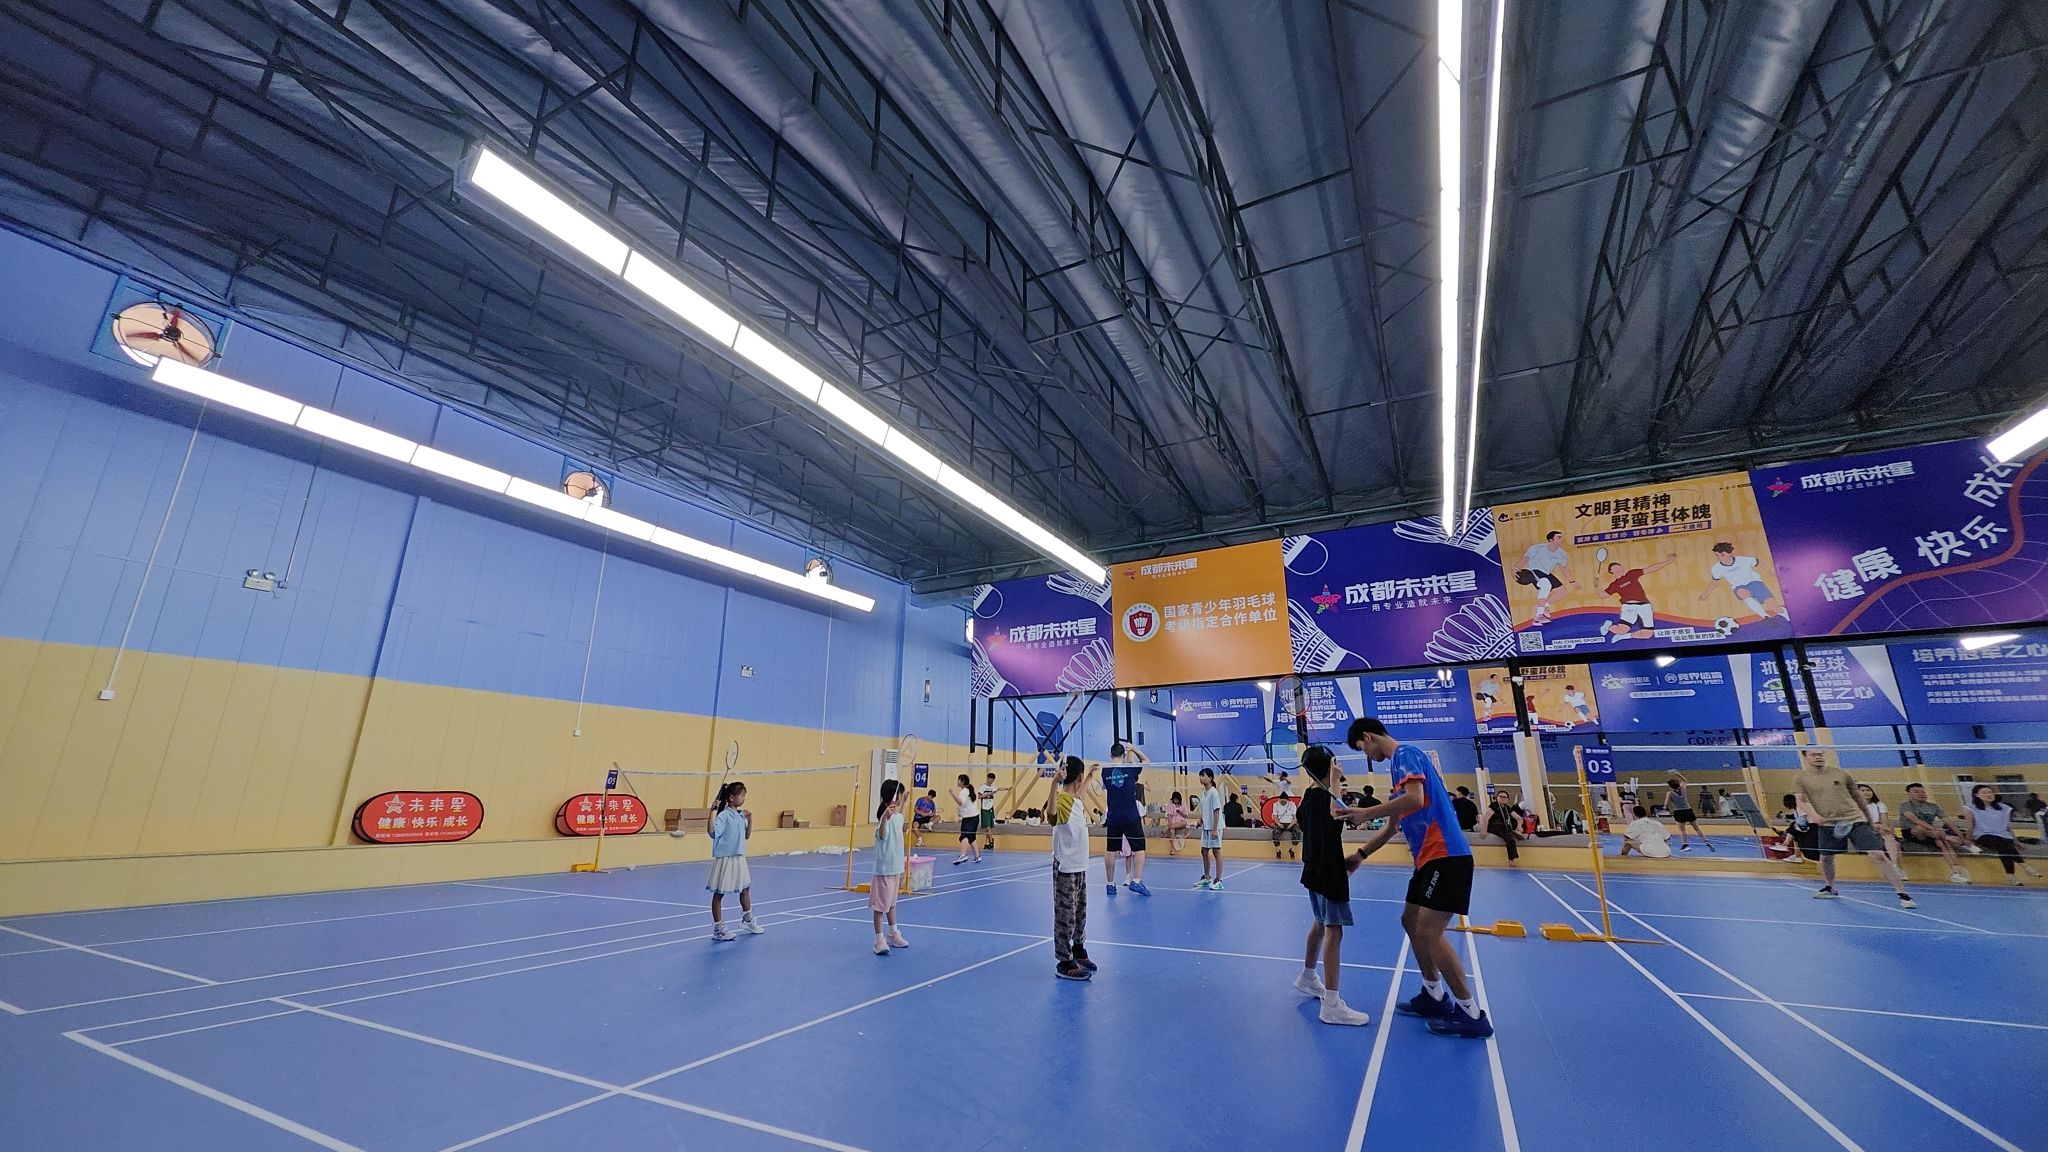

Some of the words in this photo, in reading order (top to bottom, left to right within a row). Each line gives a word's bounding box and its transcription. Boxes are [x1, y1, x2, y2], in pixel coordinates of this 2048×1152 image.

[1801, 460, 1916, 489] 成都未来星
[1575, 493, 1671, 519] 文明其精神
[1611, 504, 1712, 530] 野蛮其体魄
[1141, 558, 1198, 576] 成都未来星
[1814, 546, 1902, 602] 健康
[1914, 515, 2008, 567] 快乐
[1344, 570, 1478, 605] 成都未来星
[1163, 592, 1277, 619] 国家青少年羽毛球
[1371, 596, 1454, 612] 用专业造就未来
[1164, 607, 1278, 633] 考级指定合作单位
[1009, 617, 1097, 643] 成都未来星
[1588, 759, 1613, 774] 03
[607, 776, 616, 786] 05
[915, 772, 927, 782] 04
[408, 797, 467, 813] 未来星
[594, 799, 634, 812] 未来星
[377, 817, 407, 830] 健康
[411, 816, 439, 829] 快乐
[442, 815, 468, 828] 成长
[576, 814, 597, 825] 健康
[620, 813, 638, 824] 成长
